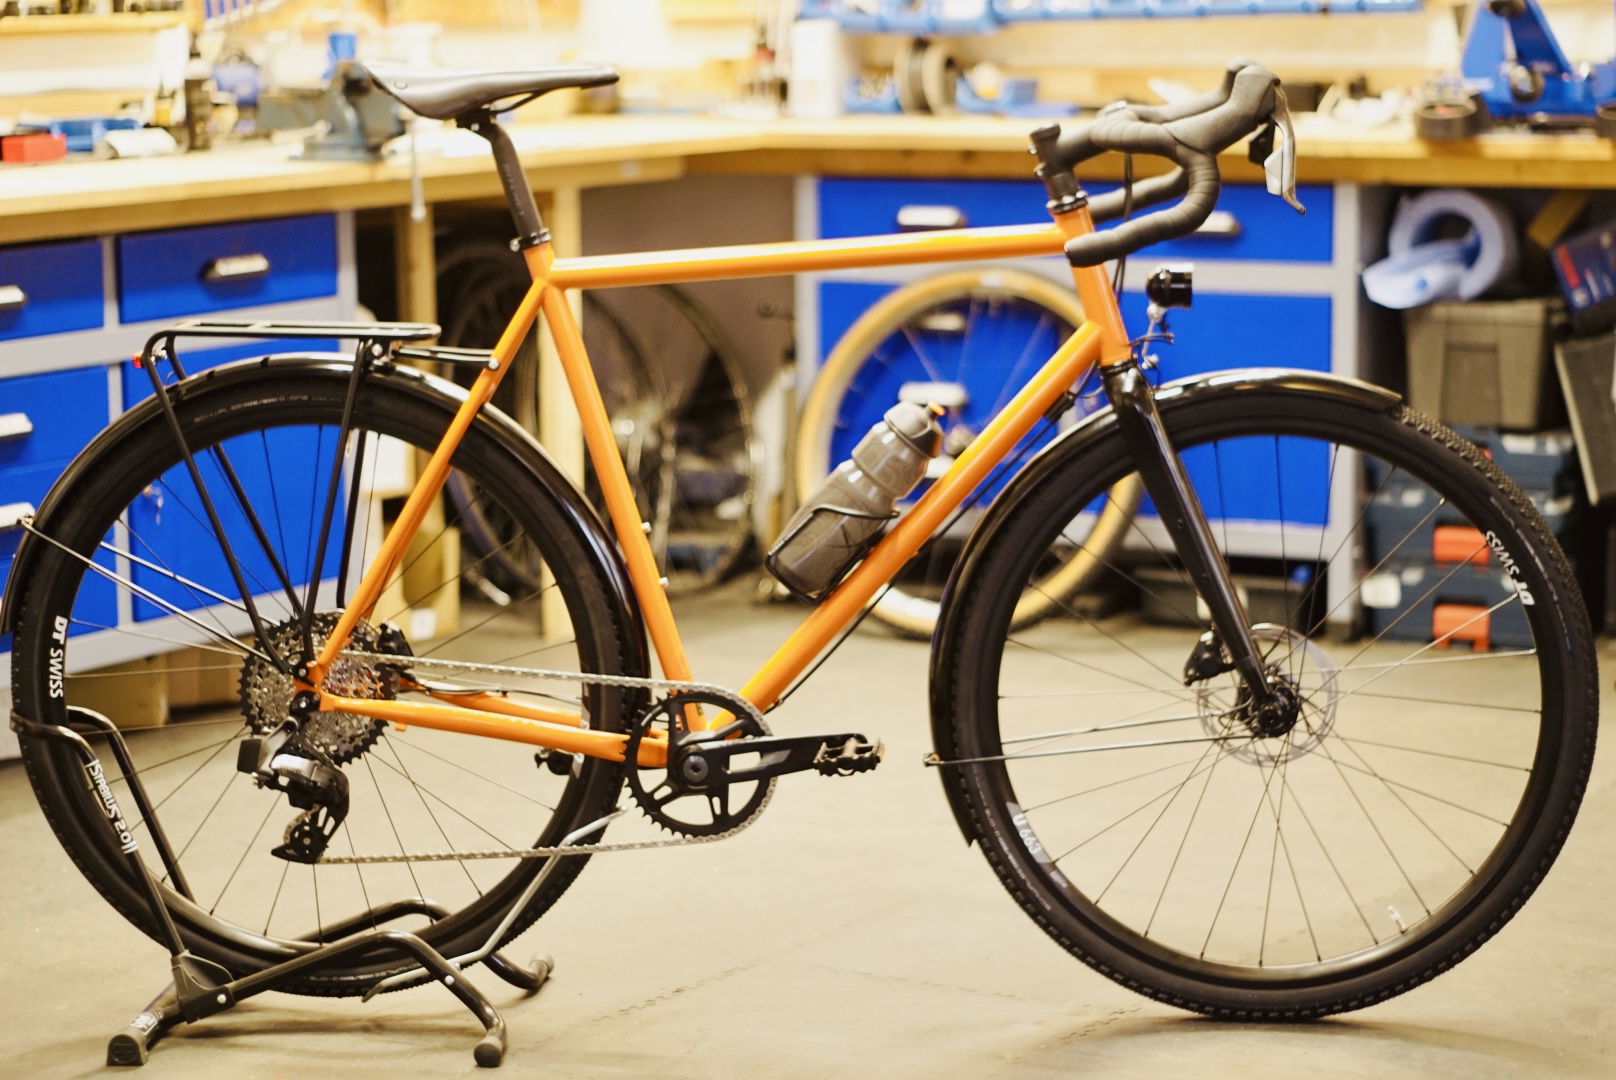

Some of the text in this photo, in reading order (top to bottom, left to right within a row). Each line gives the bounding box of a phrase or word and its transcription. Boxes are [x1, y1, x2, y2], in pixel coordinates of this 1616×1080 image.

[1486, 531, 1520, 576] SWISS
[1513, 579, 1535, 606] DT
[49, 615, 69, 698] DT SWISS
[89, 762, 132, 844] STABILUS 2.0
[1012, 812, 1041, 854] U 663
